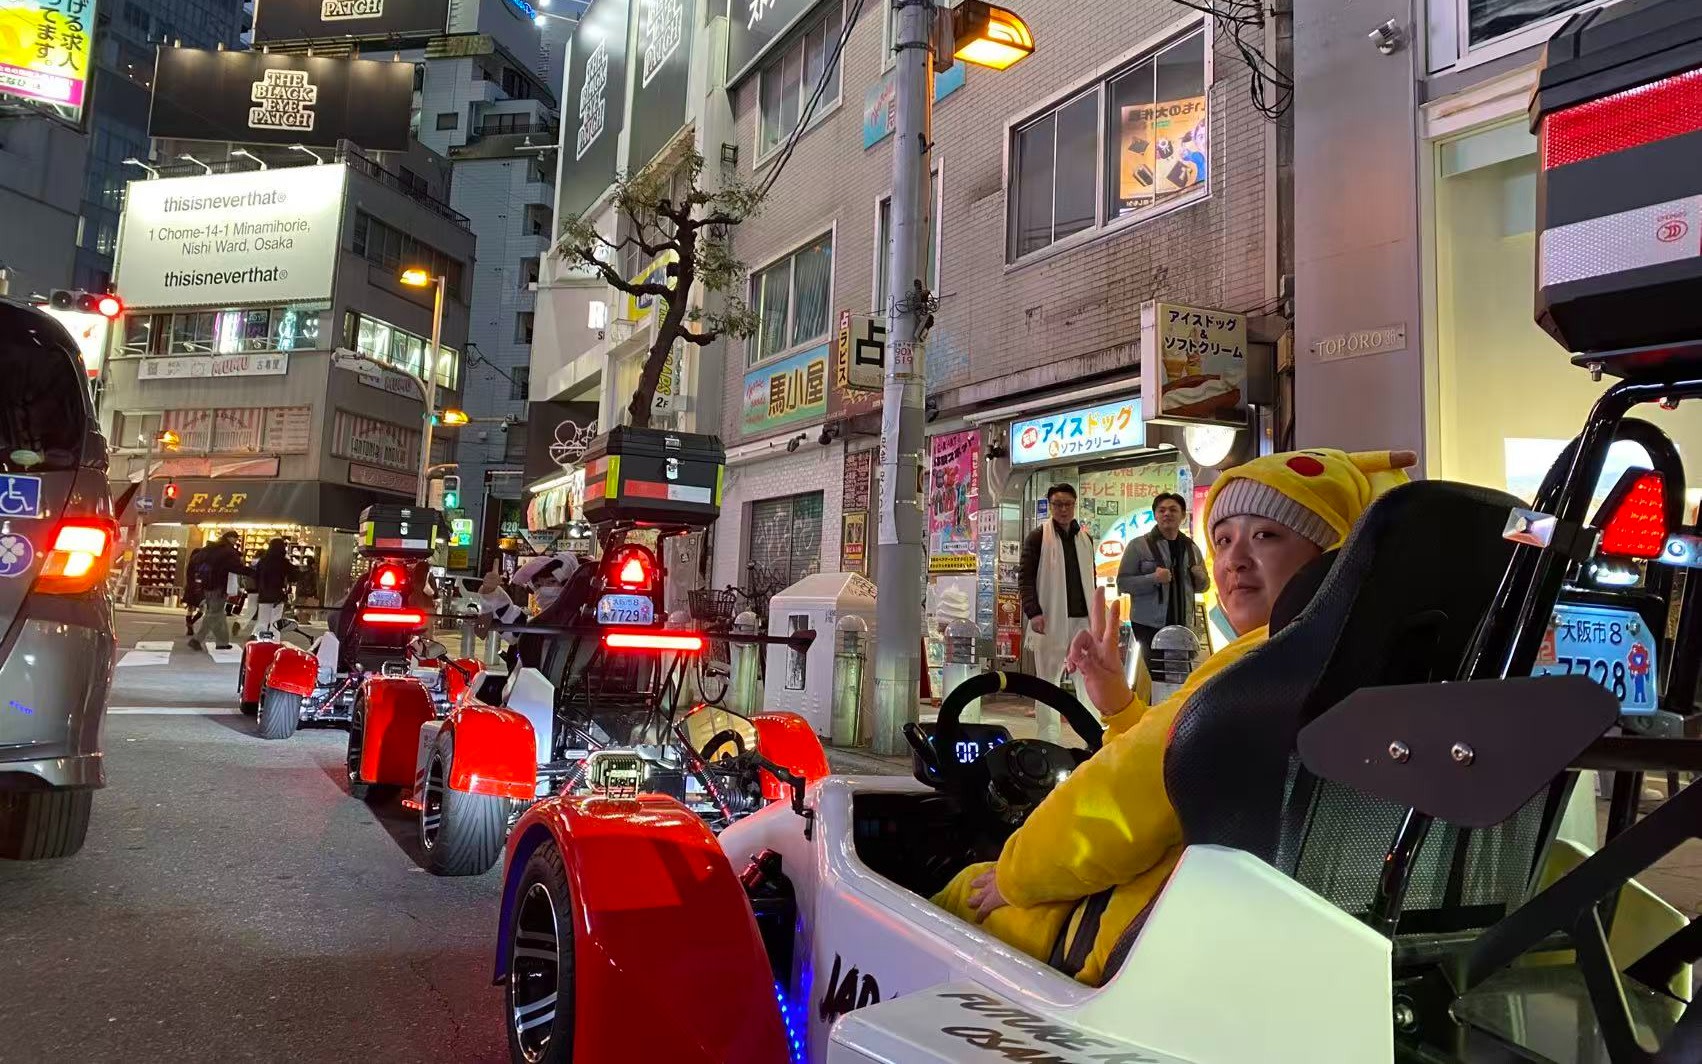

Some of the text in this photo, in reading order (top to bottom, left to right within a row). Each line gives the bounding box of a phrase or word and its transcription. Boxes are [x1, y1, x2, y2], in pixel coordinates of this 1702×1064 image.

[325, 0, 378, 17] PATCH
[267, 73, 304, 86] THE
[255, 85, 313, 101] BLACK
[266, 99, 301, 112] EYE
[252, 110, 312, 127] PATCH
[149, 218, 311, 241] 1 Chome-14-1 Minamihorie,
[182, 237, 293, 255] Nishi Ward, Osaka
[1168, 310, 1237, 331] アイスドッグ
[1200, 329, 1208, 339] &
[856, 320, 885, 368] 占
[1165, 337, 1243, 358] ソフトクリーム
[1315, 331, 1382, 356] TOPORO
[768, 360, 824, 417] 馬小屋
[655, 397, 669, 408] 2F
[1041, 404, 1133, 442] アイスドッグ
[1061, 434, 1121, 454] ソフトクリーム
[1081, 482, 1116, 497] テレビ
[610, 608, 640, 622] 7729
[955, 741, 979, 764] 00
